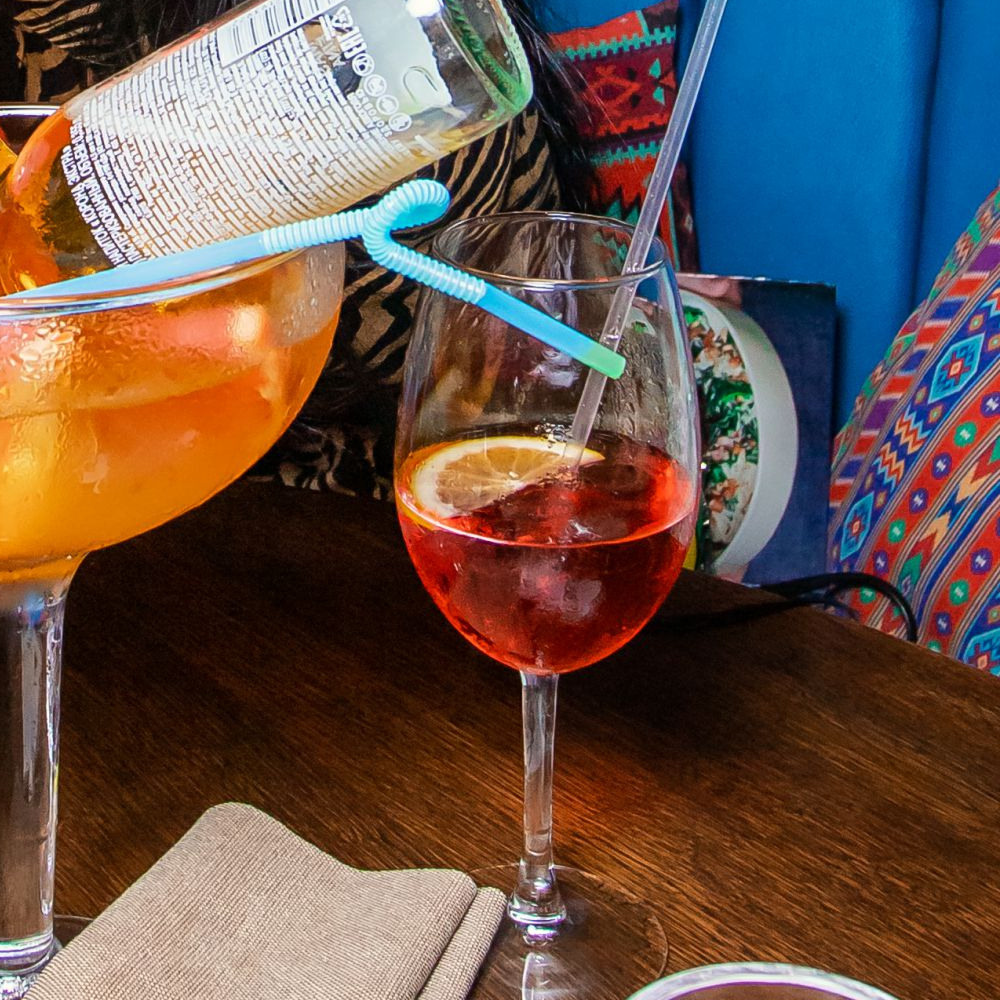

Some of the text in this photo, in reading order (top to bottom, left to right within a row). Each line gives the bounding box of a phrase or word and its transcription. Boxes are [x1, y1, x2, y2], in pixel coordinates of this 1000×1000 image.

[60, 144, 125, 265] НАПИТОК «КОРОНА ЭКСТРА»
